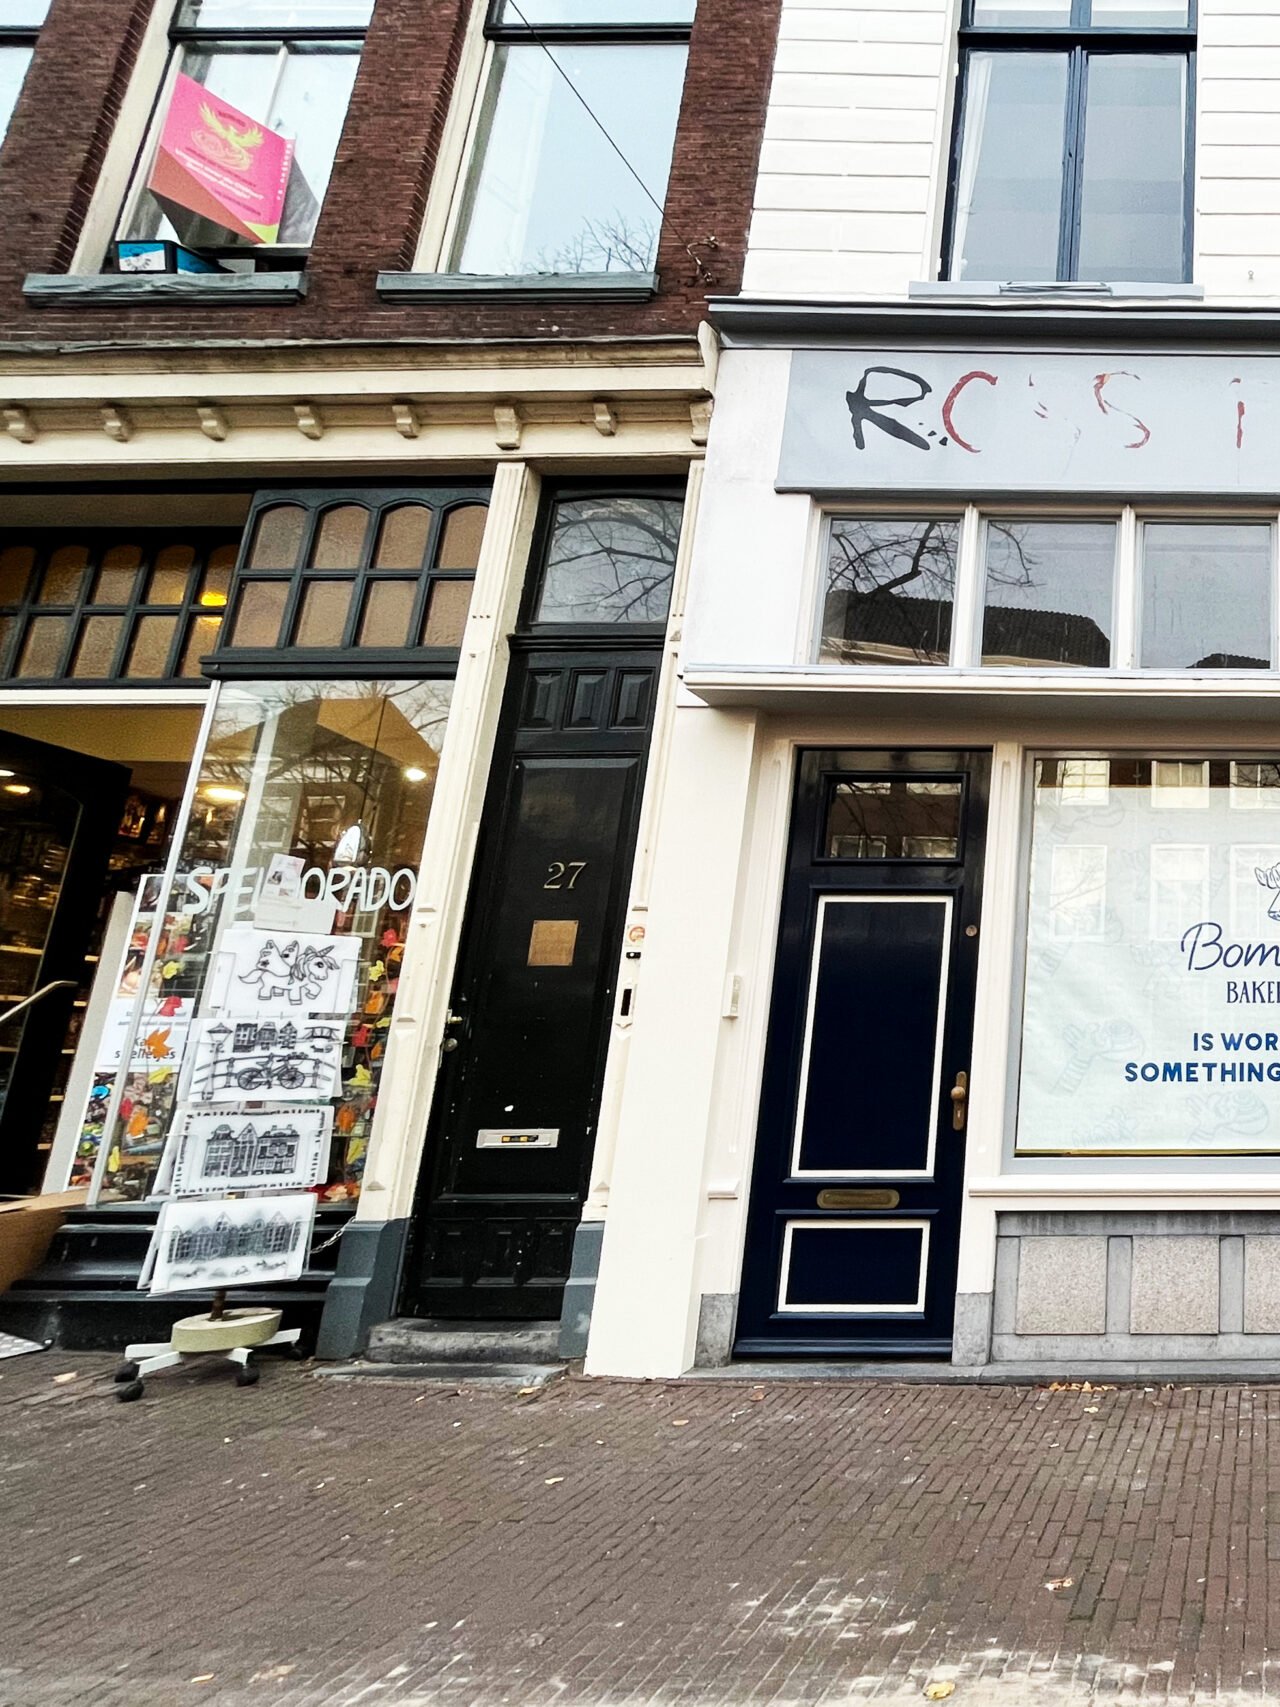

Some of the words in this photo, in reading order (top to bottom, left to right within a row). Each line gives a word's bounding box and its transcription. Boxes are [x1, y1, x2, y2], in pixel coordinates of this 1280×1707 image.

[182, 866, 417, 914] SPELORADO
[543, 861, 587, 890] 27
[1193, 1032, 1214, 1051] IS
